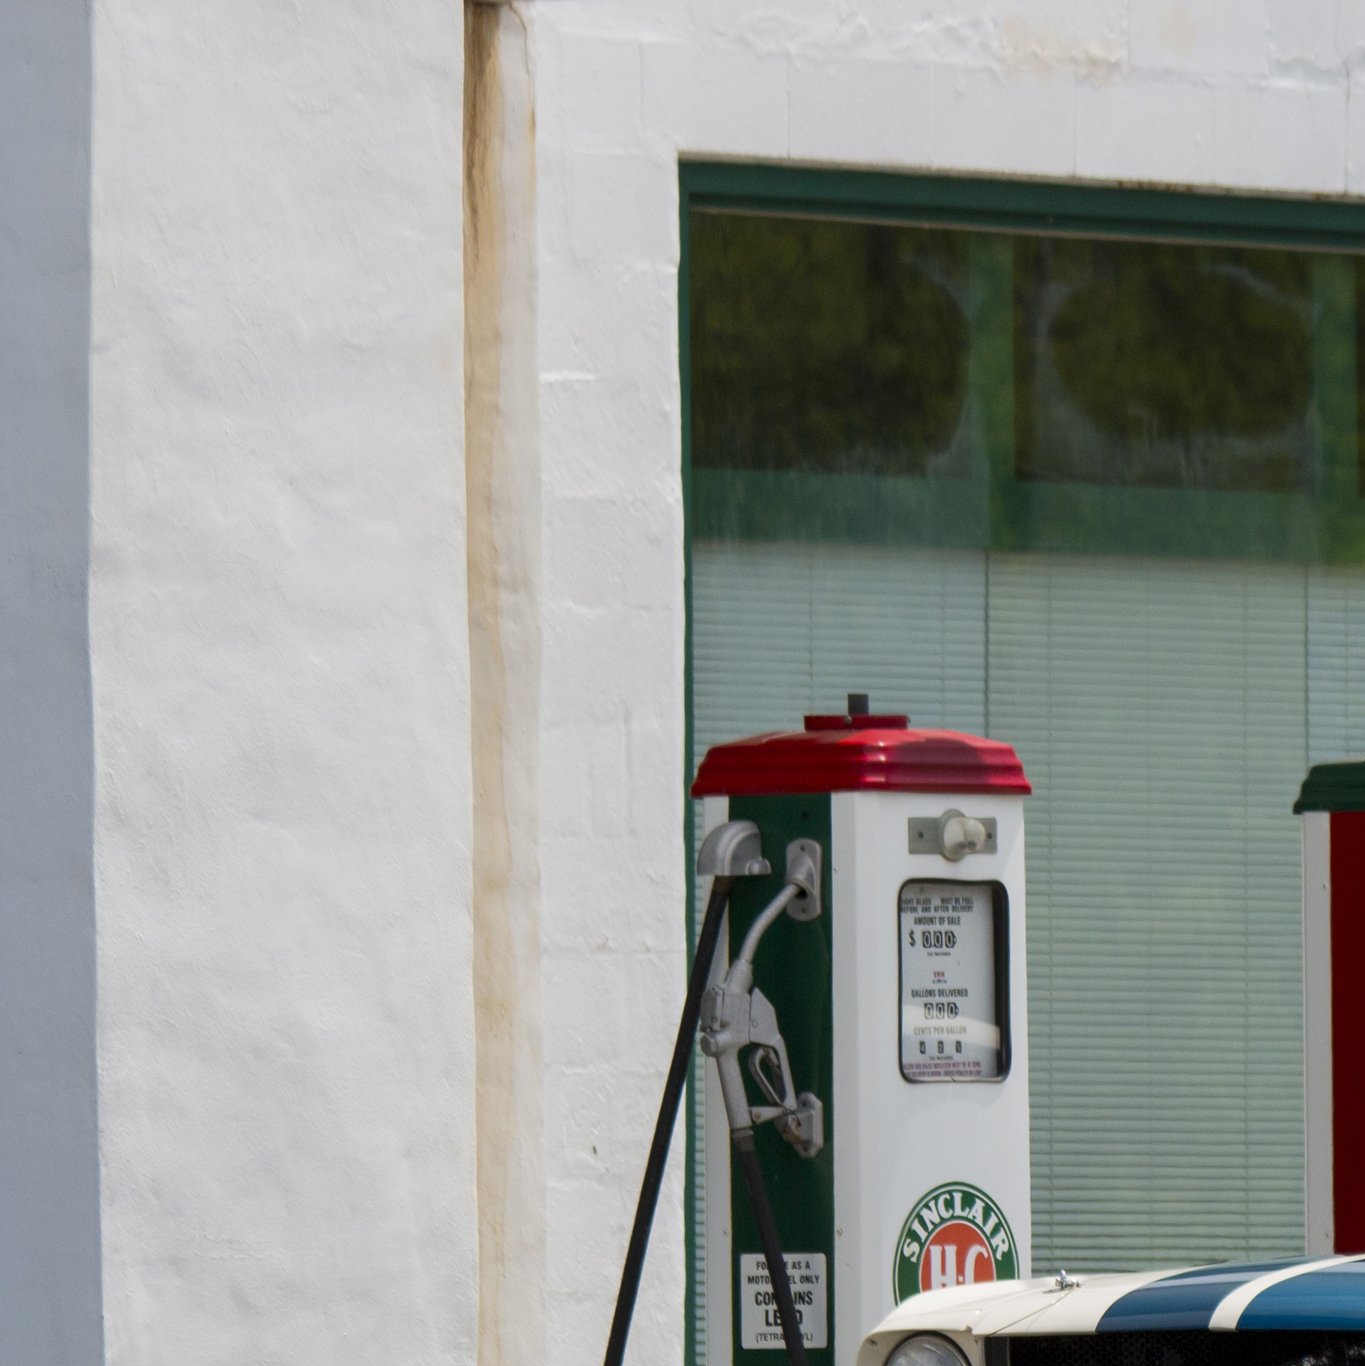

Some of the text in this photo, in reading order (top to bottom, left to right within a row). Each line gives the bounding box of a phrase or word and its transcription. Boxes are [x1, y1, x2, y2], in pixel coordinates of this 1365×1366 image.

[914, 916, 961, 926] AMOUNT OF SALE
[908, 929, 916, 947] $
[911, 988, 969, 998] GALLONS DELIVERED
[914, 1025, 967, 1036] CENTS PER GALLON
[903, 1192, 1009, 1263] SINCLAIR
[792, 1261, 802, 1270] AS
[805, 1261, 811, 1270] A
[747, 1276, 770, 1285] MOTO
[799, 1275, 820, 1285] ONLY
